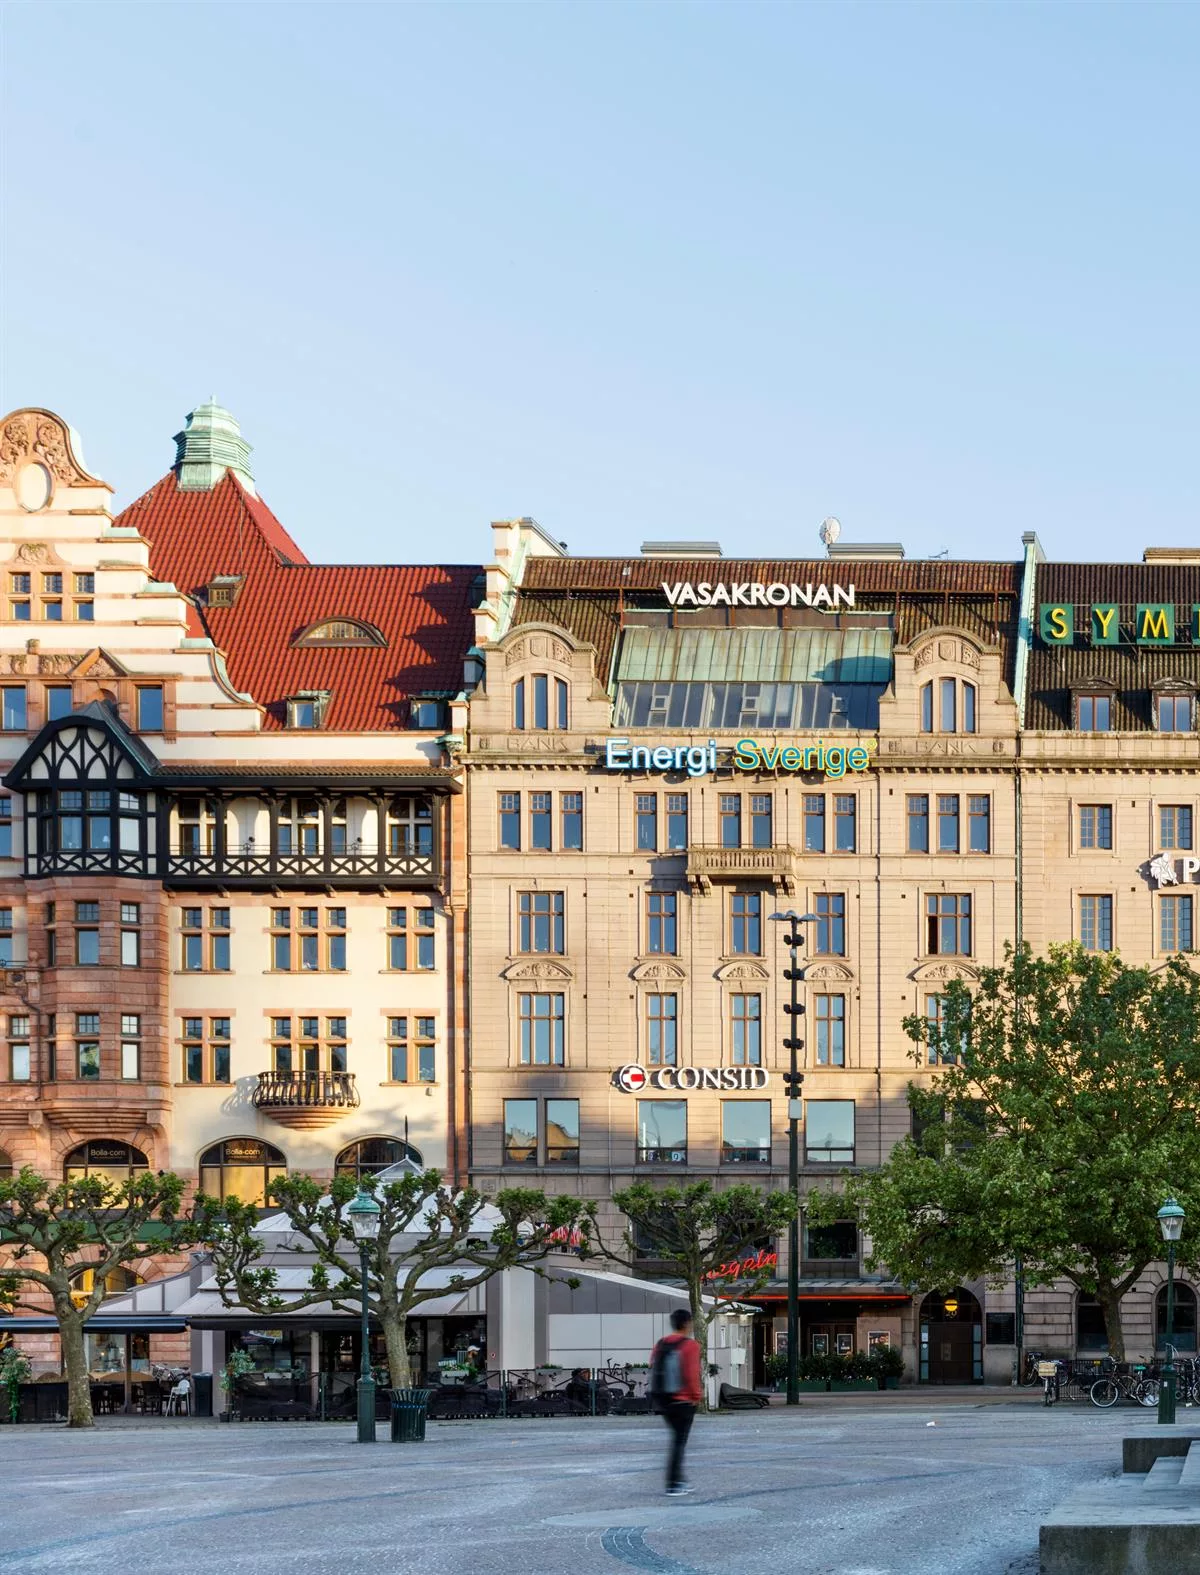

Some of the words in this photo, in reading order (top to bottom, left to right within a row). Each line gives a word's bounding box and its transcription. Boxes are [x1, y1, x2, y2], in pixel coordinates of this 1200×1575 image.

[661, 581, 855, 607] VASAKRONAN
[605, 738, 716, 777] Energi
[657, 1067, 770, 1089] CONSID
